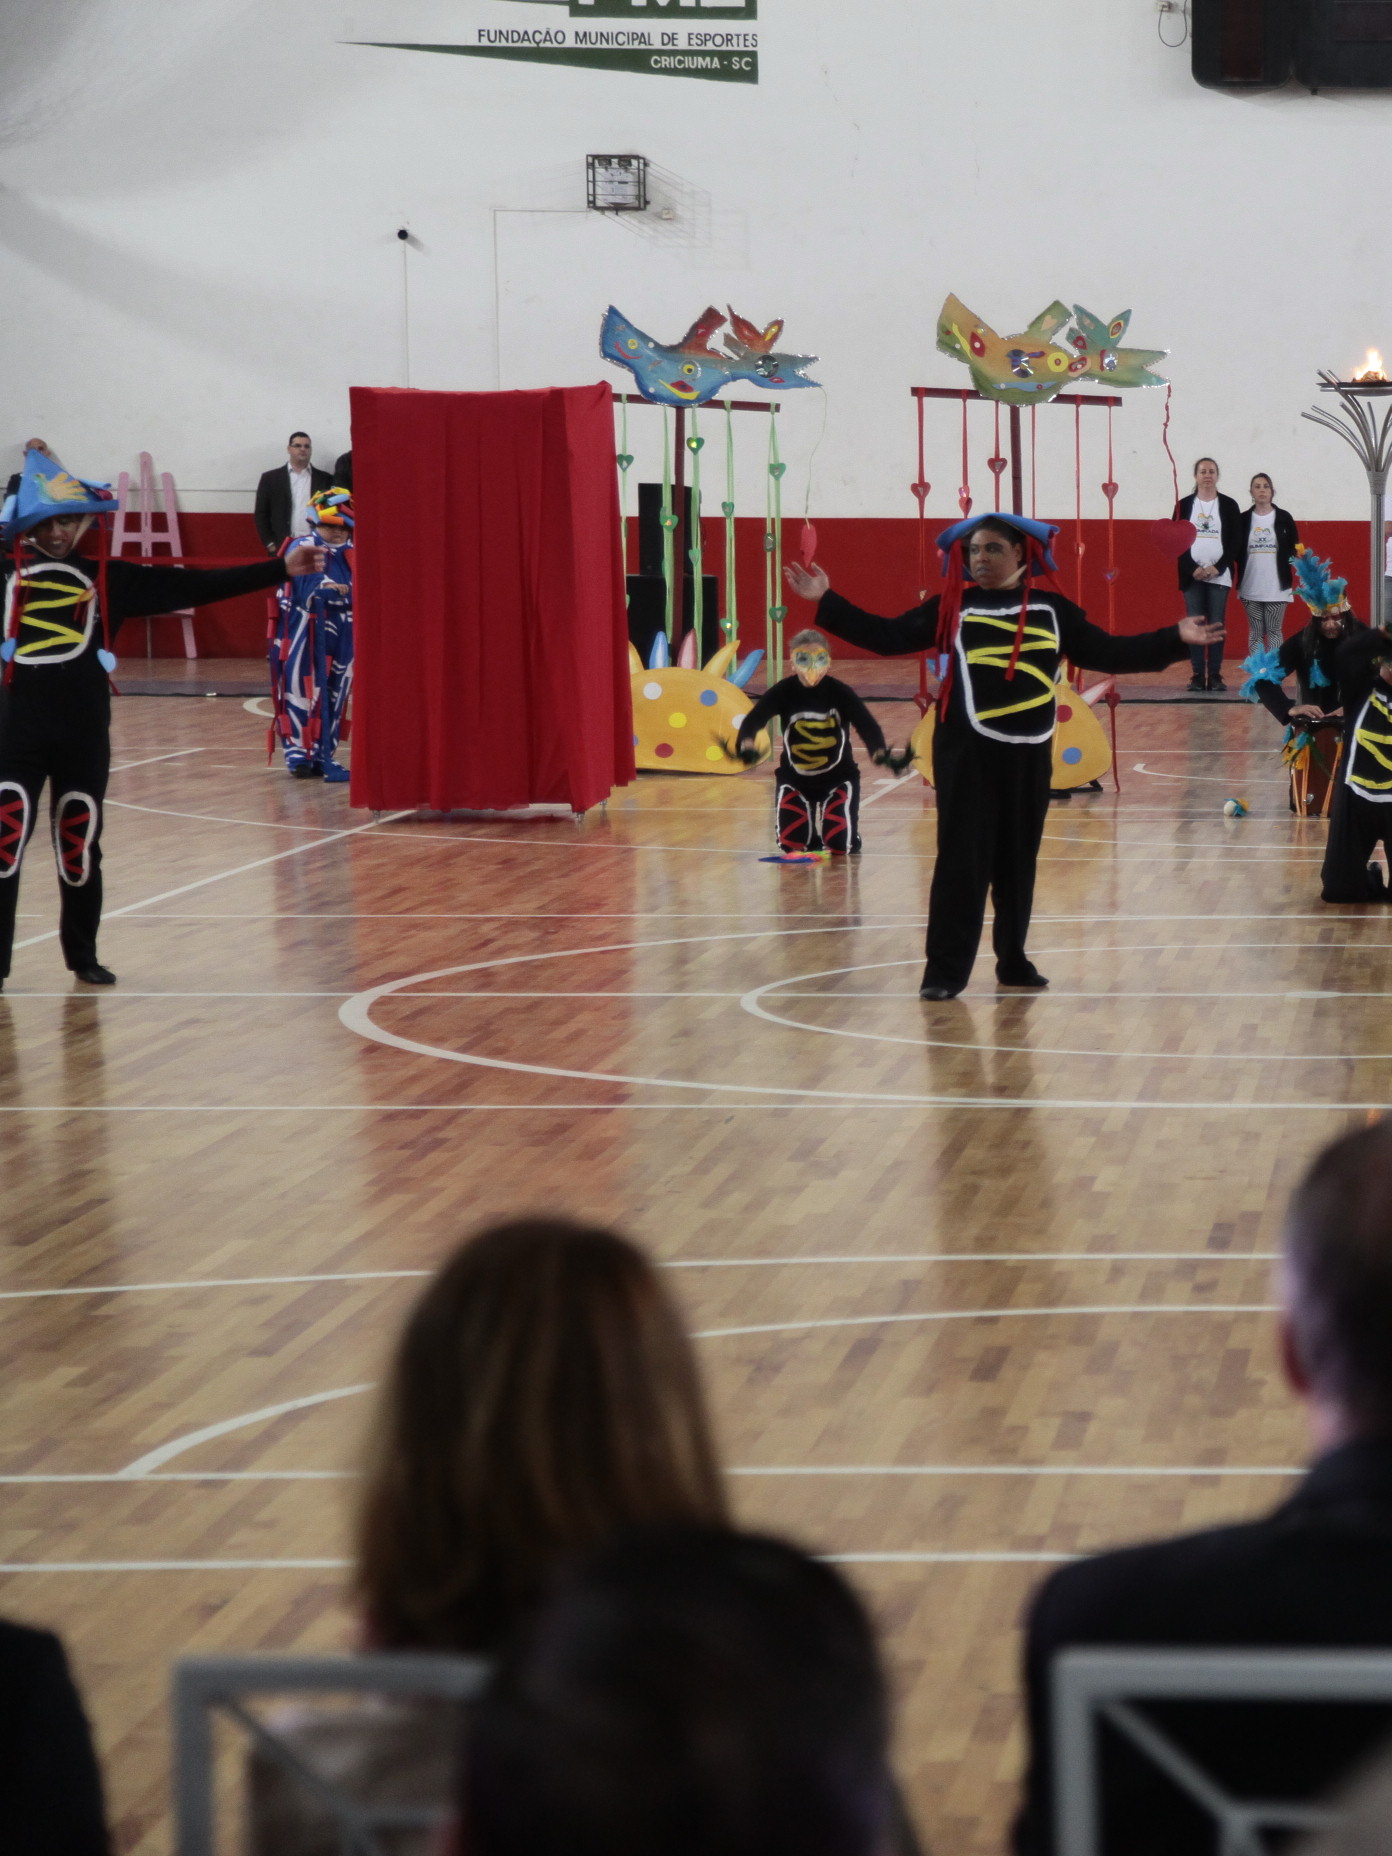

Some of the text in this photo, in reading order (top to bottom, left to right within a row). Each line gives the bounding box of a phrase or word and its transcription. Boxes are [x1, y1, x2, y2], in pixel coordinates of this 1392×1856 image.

[478, 28, 758, 48] FUNDAÇÃO MUNICIPAL DE ESPORTES
[650, 55, 721, 69] CRICIUMA
[731, 57, 752, 71] SC
